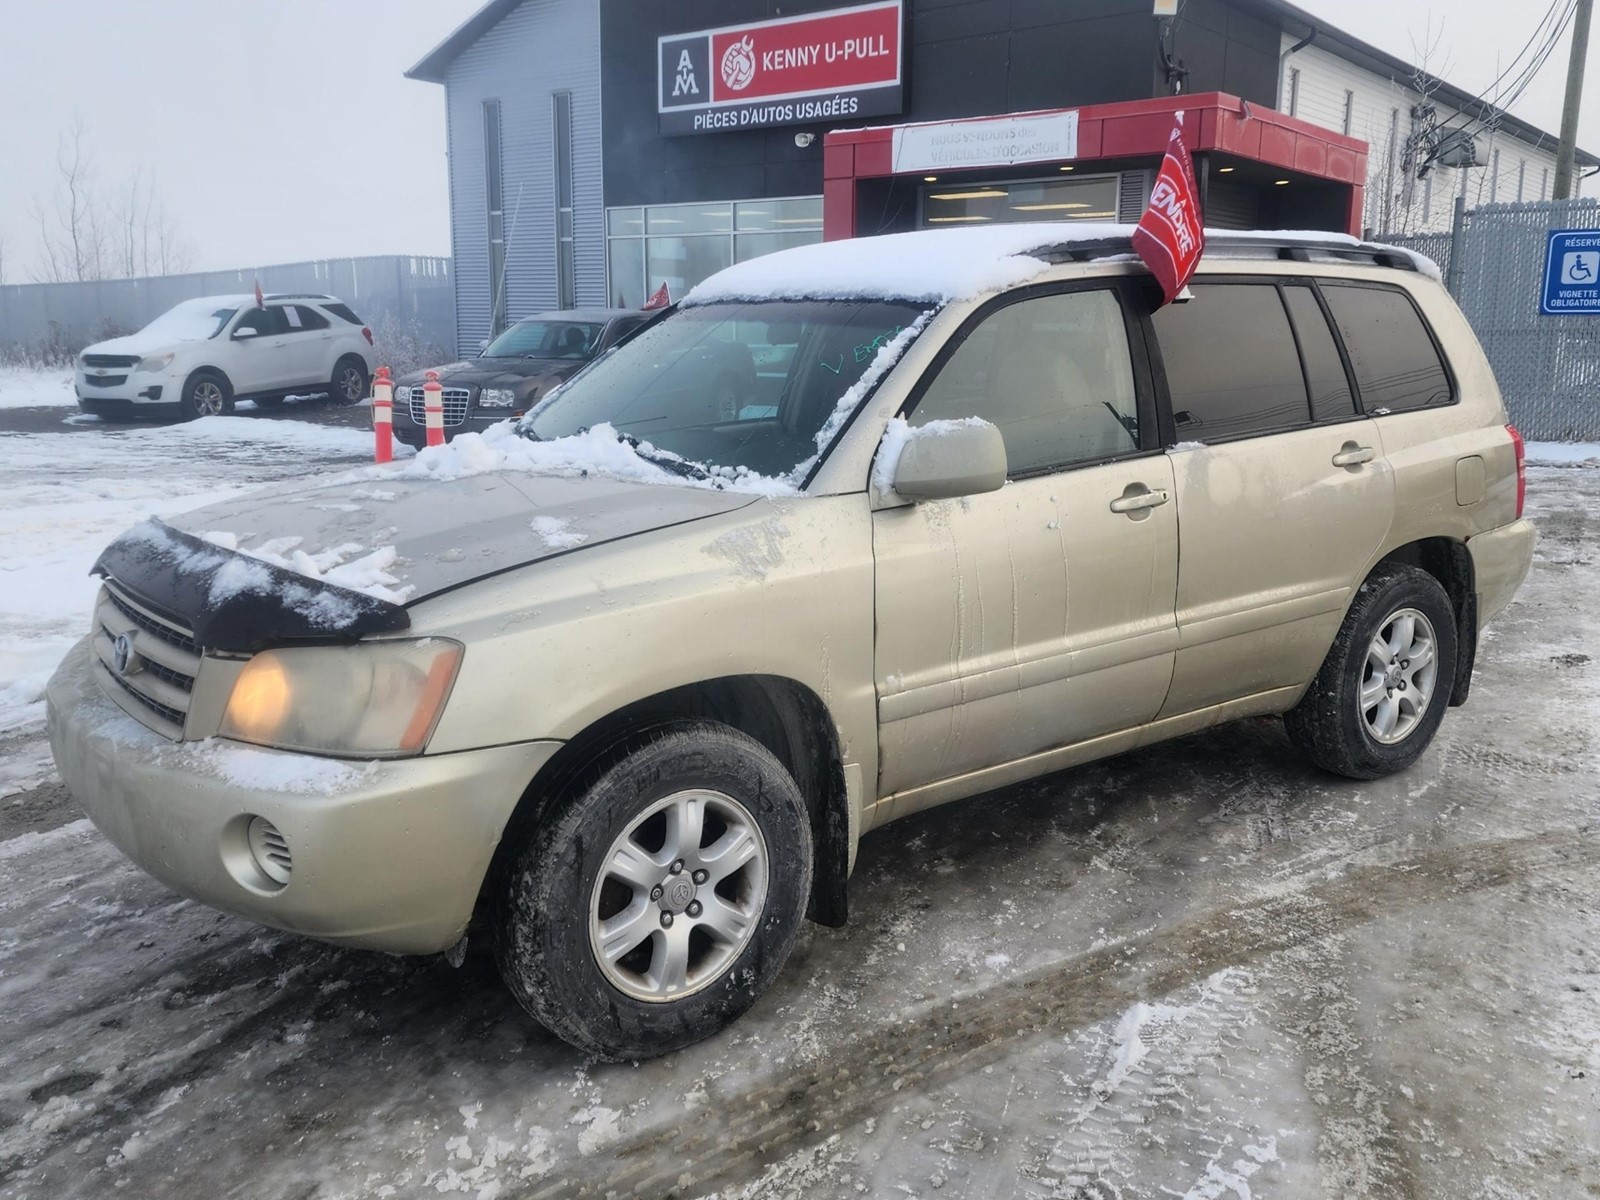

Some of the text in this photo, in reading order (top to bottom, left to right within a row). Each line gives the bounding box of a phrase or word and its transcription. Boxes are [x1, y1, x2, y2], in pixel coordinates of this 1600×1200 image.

[762, 35, 889, 71] KENNY U-PULL
[694, 95, 858, 130] PIÈCES D'AUTOS USAGÉES
[931, 132, 961, 146] NOUS
[1559, 289, 1598, 298] VIGNETTE
